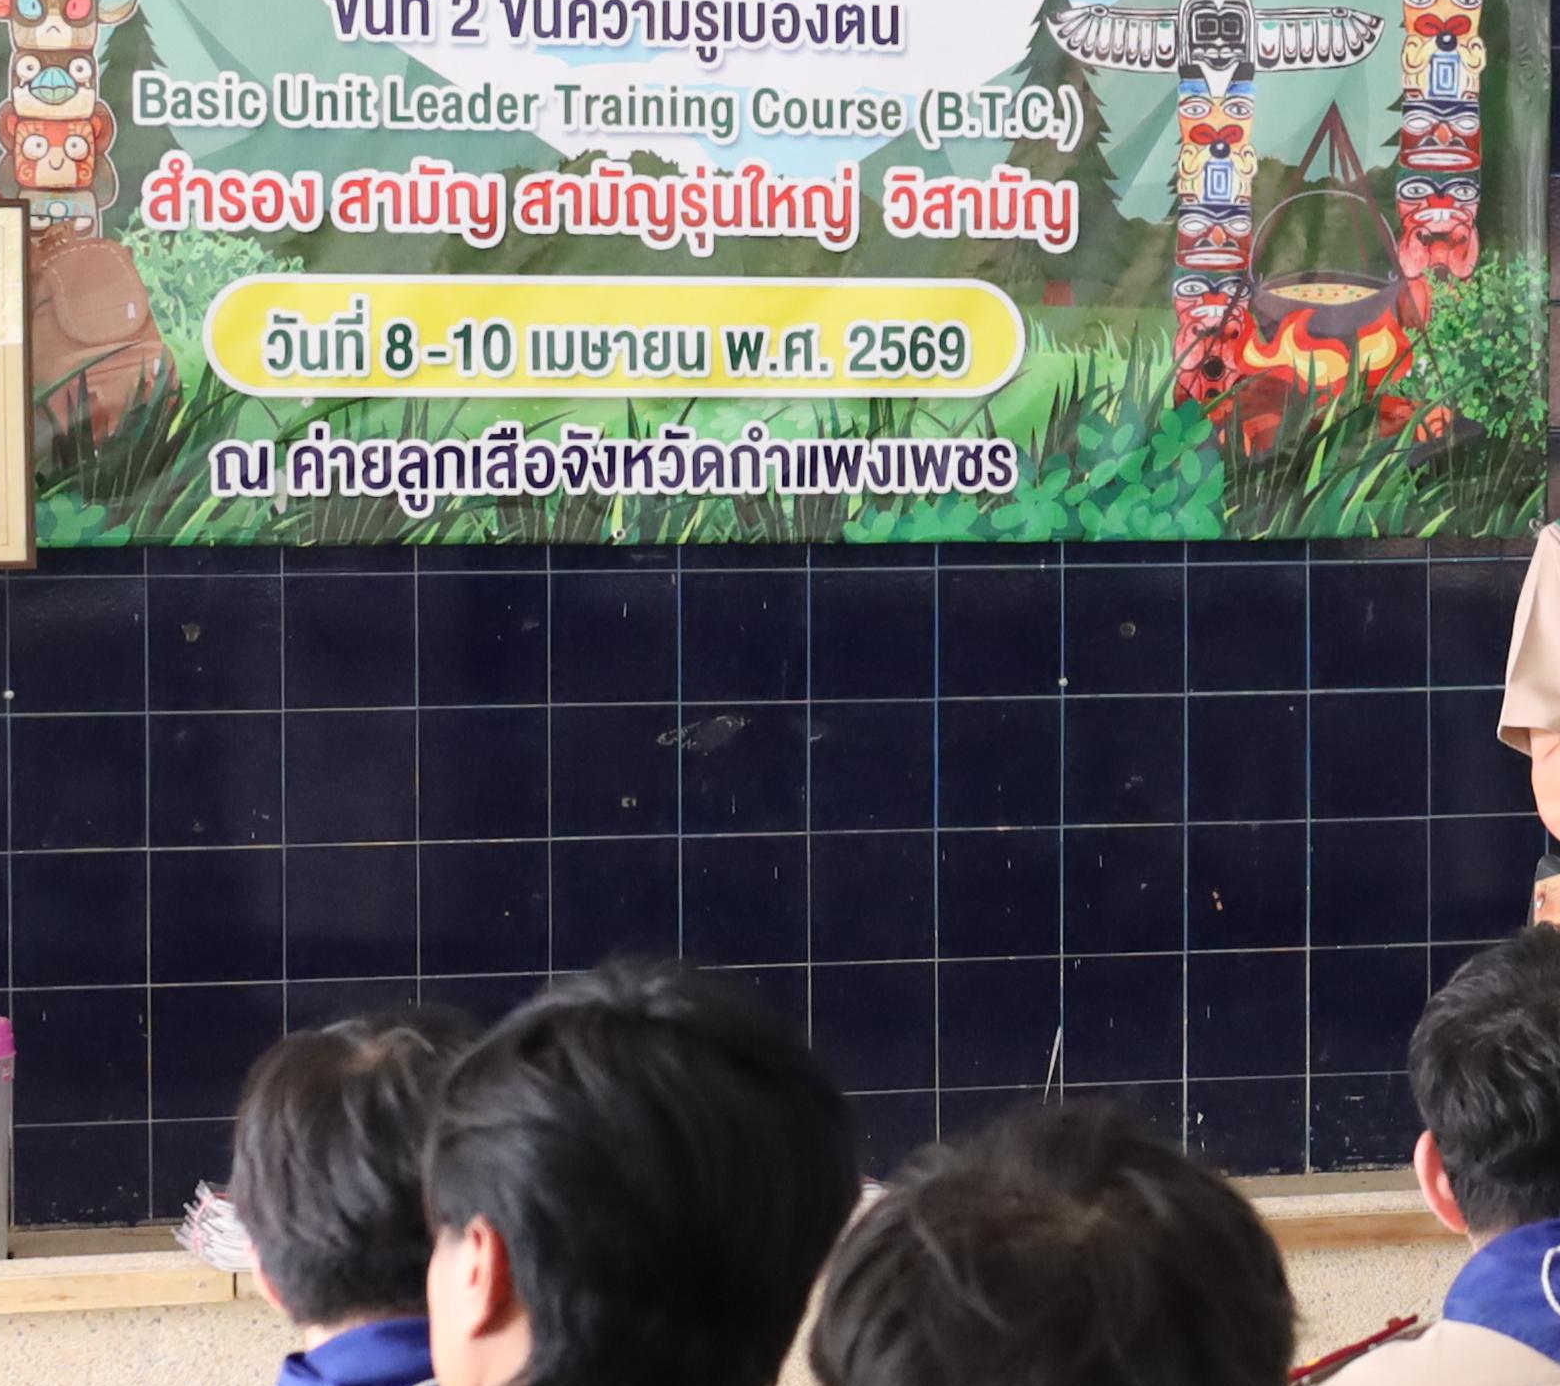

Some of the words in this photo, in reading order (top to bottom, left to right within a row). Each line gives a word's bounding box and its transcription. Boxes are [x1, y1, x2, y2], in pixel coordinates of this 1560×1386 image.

[139, 77, 261, 121] Basic
[279, 78, 372, 123] Unit
[389, 80, 539, 125] Leader
[555, 84, 734, 138] Training
[752, 87, 902, 131] Course
[919, 87, 1081, 148] (B.T.C.)
[148, 158, 316, 224] สำรอง
[339, 164, 499, 240] สามัญ
[520, 164, 853, 249] สามัญรุ่นใหญ่
[889, 173, 1072, 246] วิสามัญ
[266, 298, 365, 371] วันที่
[530, 329, 706, 373] เมษายน
[725, 328, 829, 373] พ.ศ.
[848, 325, 966, 373] 2569
[217, 445, 268, 491] ณ
[292, 427, 1014, 512] ค่ายลูกเสือจังหวัดกำแพงเพชร
